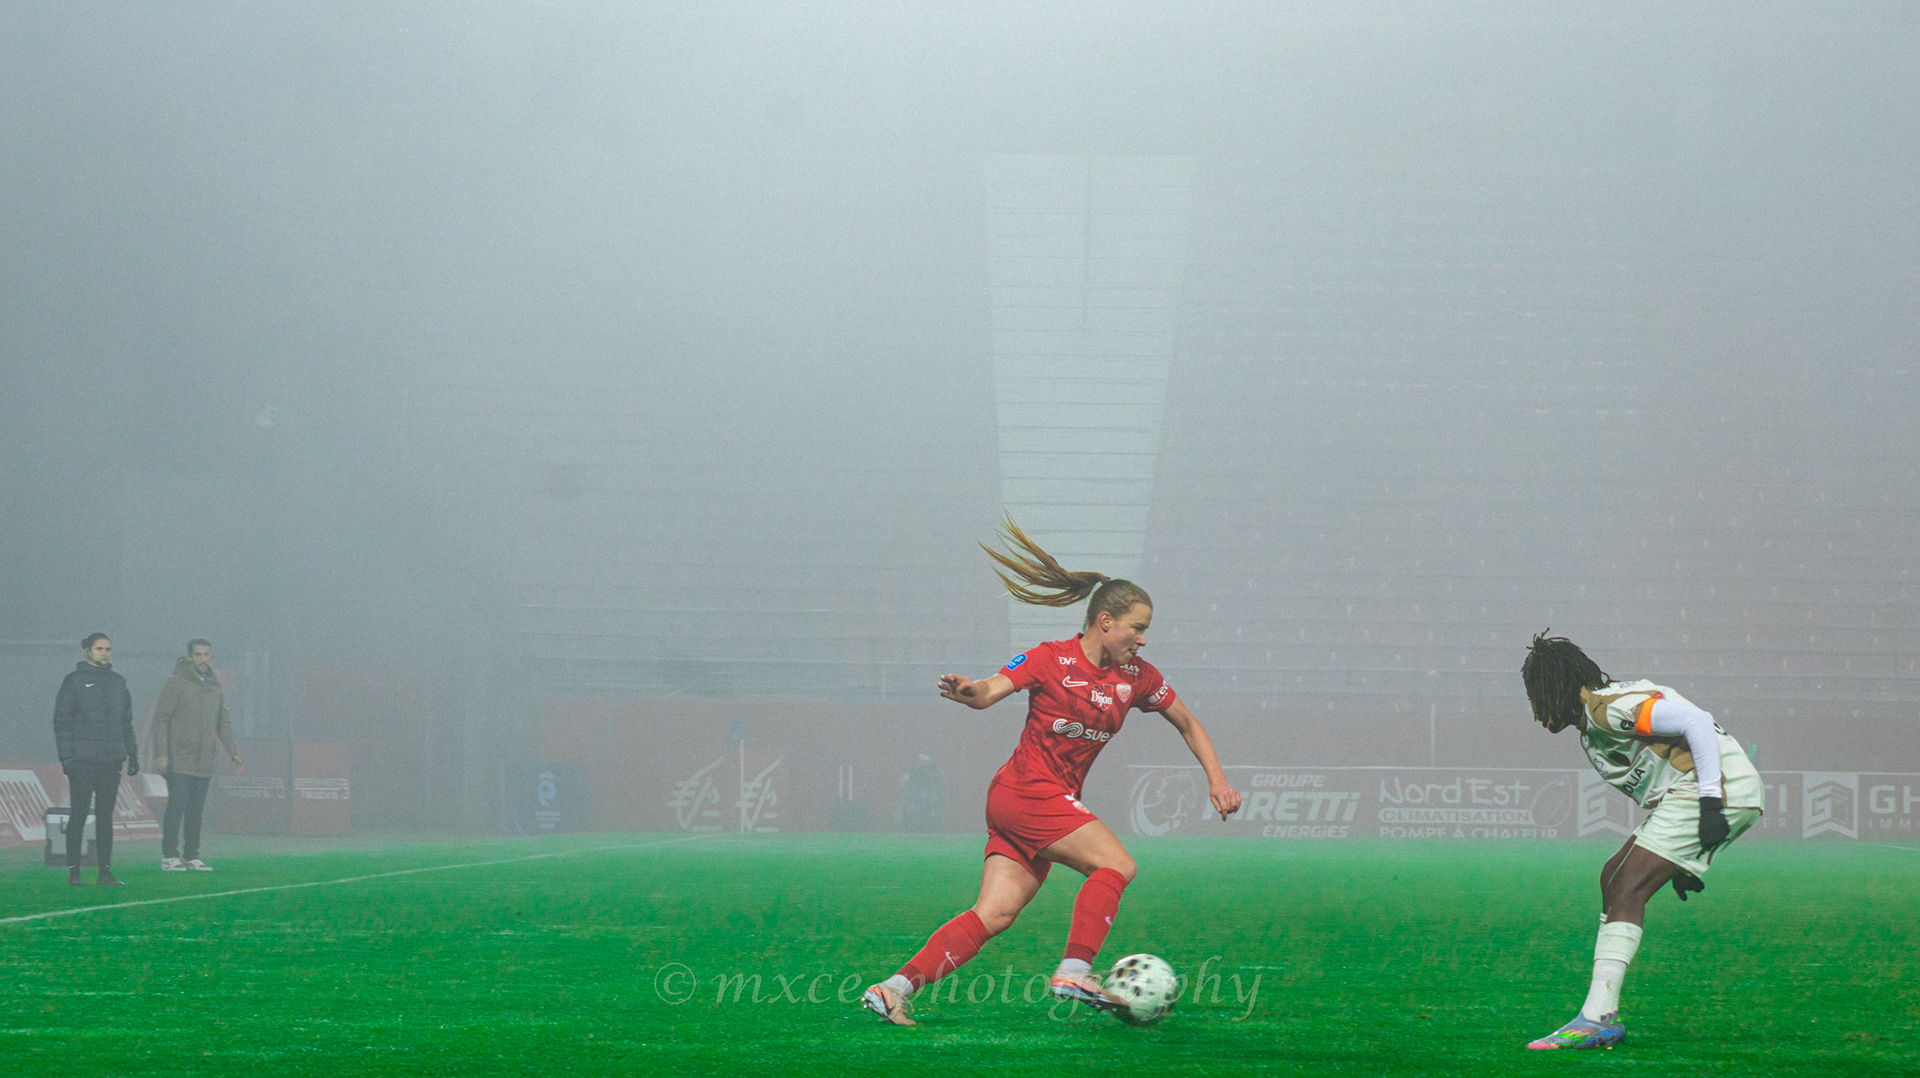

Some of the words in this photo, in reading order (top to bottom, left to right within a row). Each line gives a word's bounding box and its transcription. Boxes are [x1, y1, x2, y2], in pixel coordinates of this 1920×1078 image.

[1090, 690, 1113, 707] Dijon
[1082, 728, 1115, 743] sue
[1251, 773, 1325, 787] GROUPE
[1383, 809, 1530, 823] CLIMATISATION
